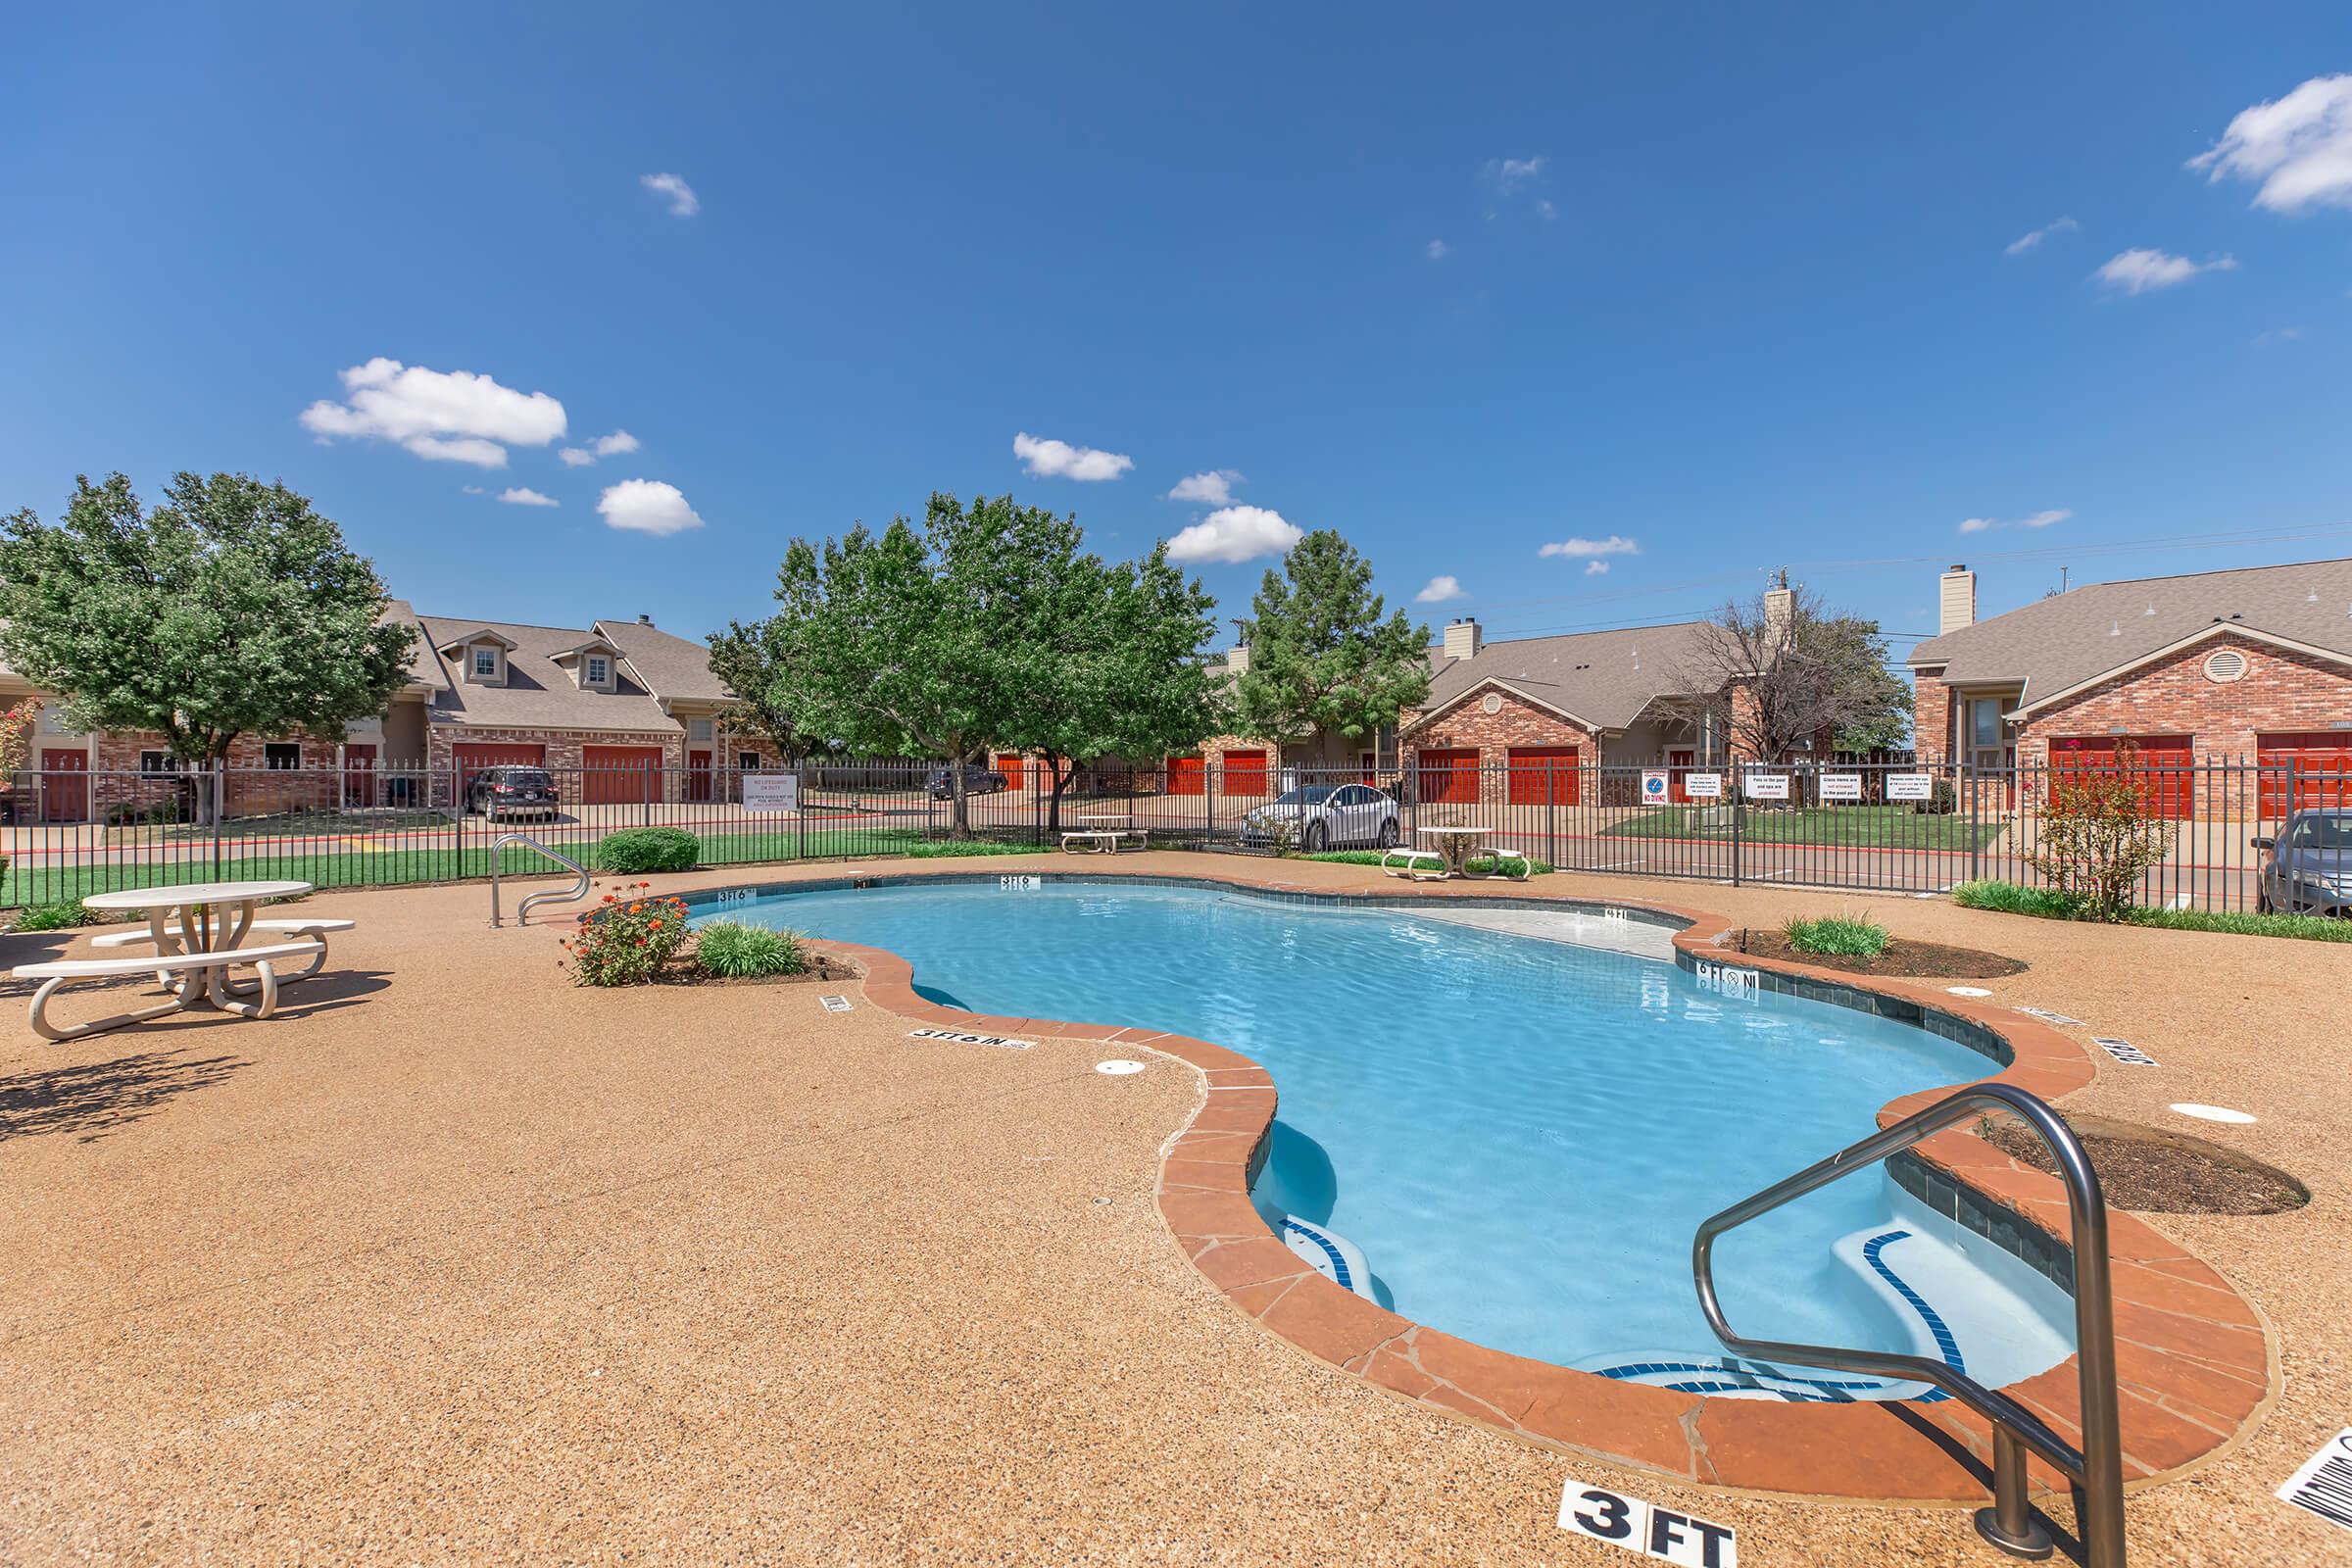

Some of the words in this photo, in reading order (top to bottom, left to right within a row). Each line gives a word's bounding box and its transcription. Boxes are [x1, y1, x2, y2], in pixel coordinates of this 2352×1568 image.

[1003, 875, 1009, 884] 3
[1022, 875, 1029, 884] 6
[720, 892, 726, 902] 3
[739, 889, 745, 900] 6
[1700, 961, 1707, 974] 6
[980, 1037, 1007, 1046] IN
[1574, 1491, 1632, 1540] 3
[1650, 1507, 1733, 1568] FT
